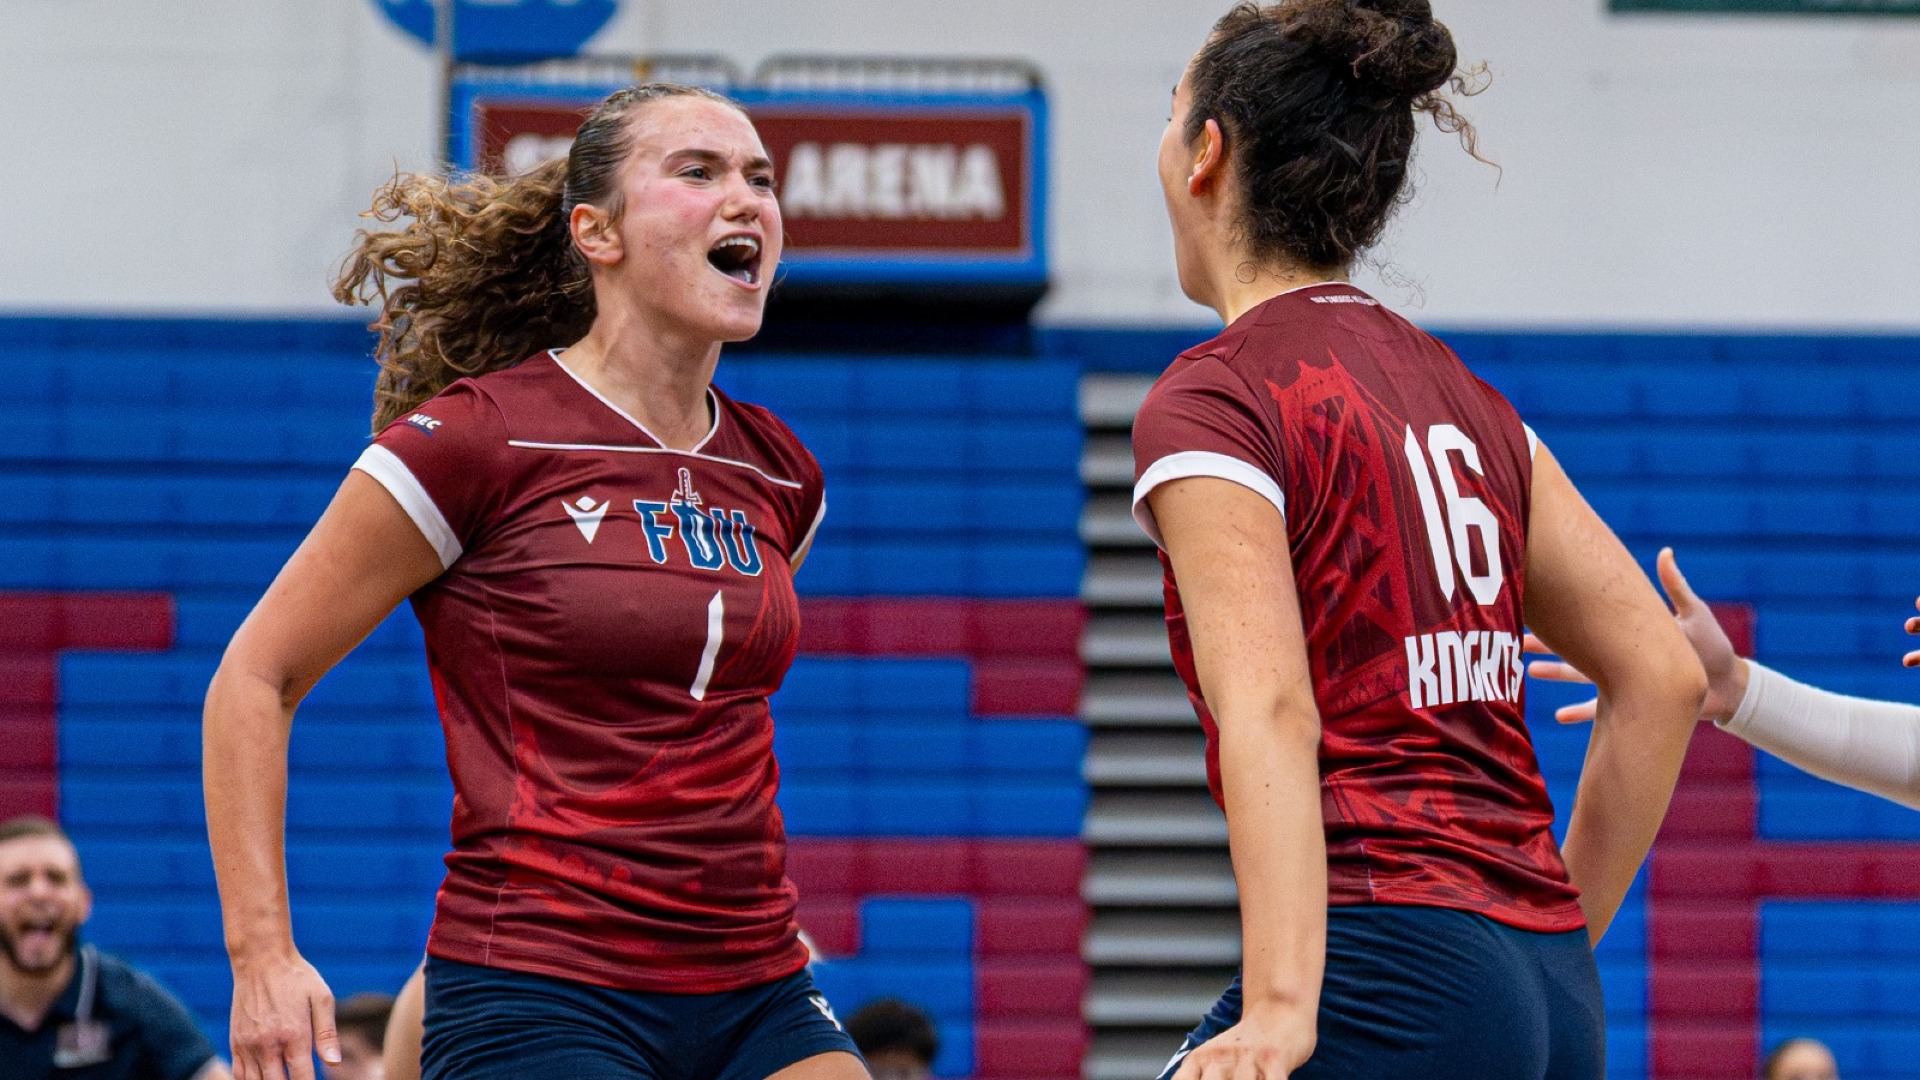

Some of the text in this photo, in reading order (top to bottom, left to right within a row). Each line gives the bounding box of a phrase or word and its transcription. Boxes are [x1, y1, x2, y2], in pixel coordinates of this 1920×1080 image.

[782, 142, 1005, 220] ARENA
[407, 413, 443, 431] NEC
[633, 498, 763, 577] FDU
[1404, 424, 1503, 606] 16
[690, 589, 724, 701] 1
[1404, 630, 1524, 710] KNGHTS
